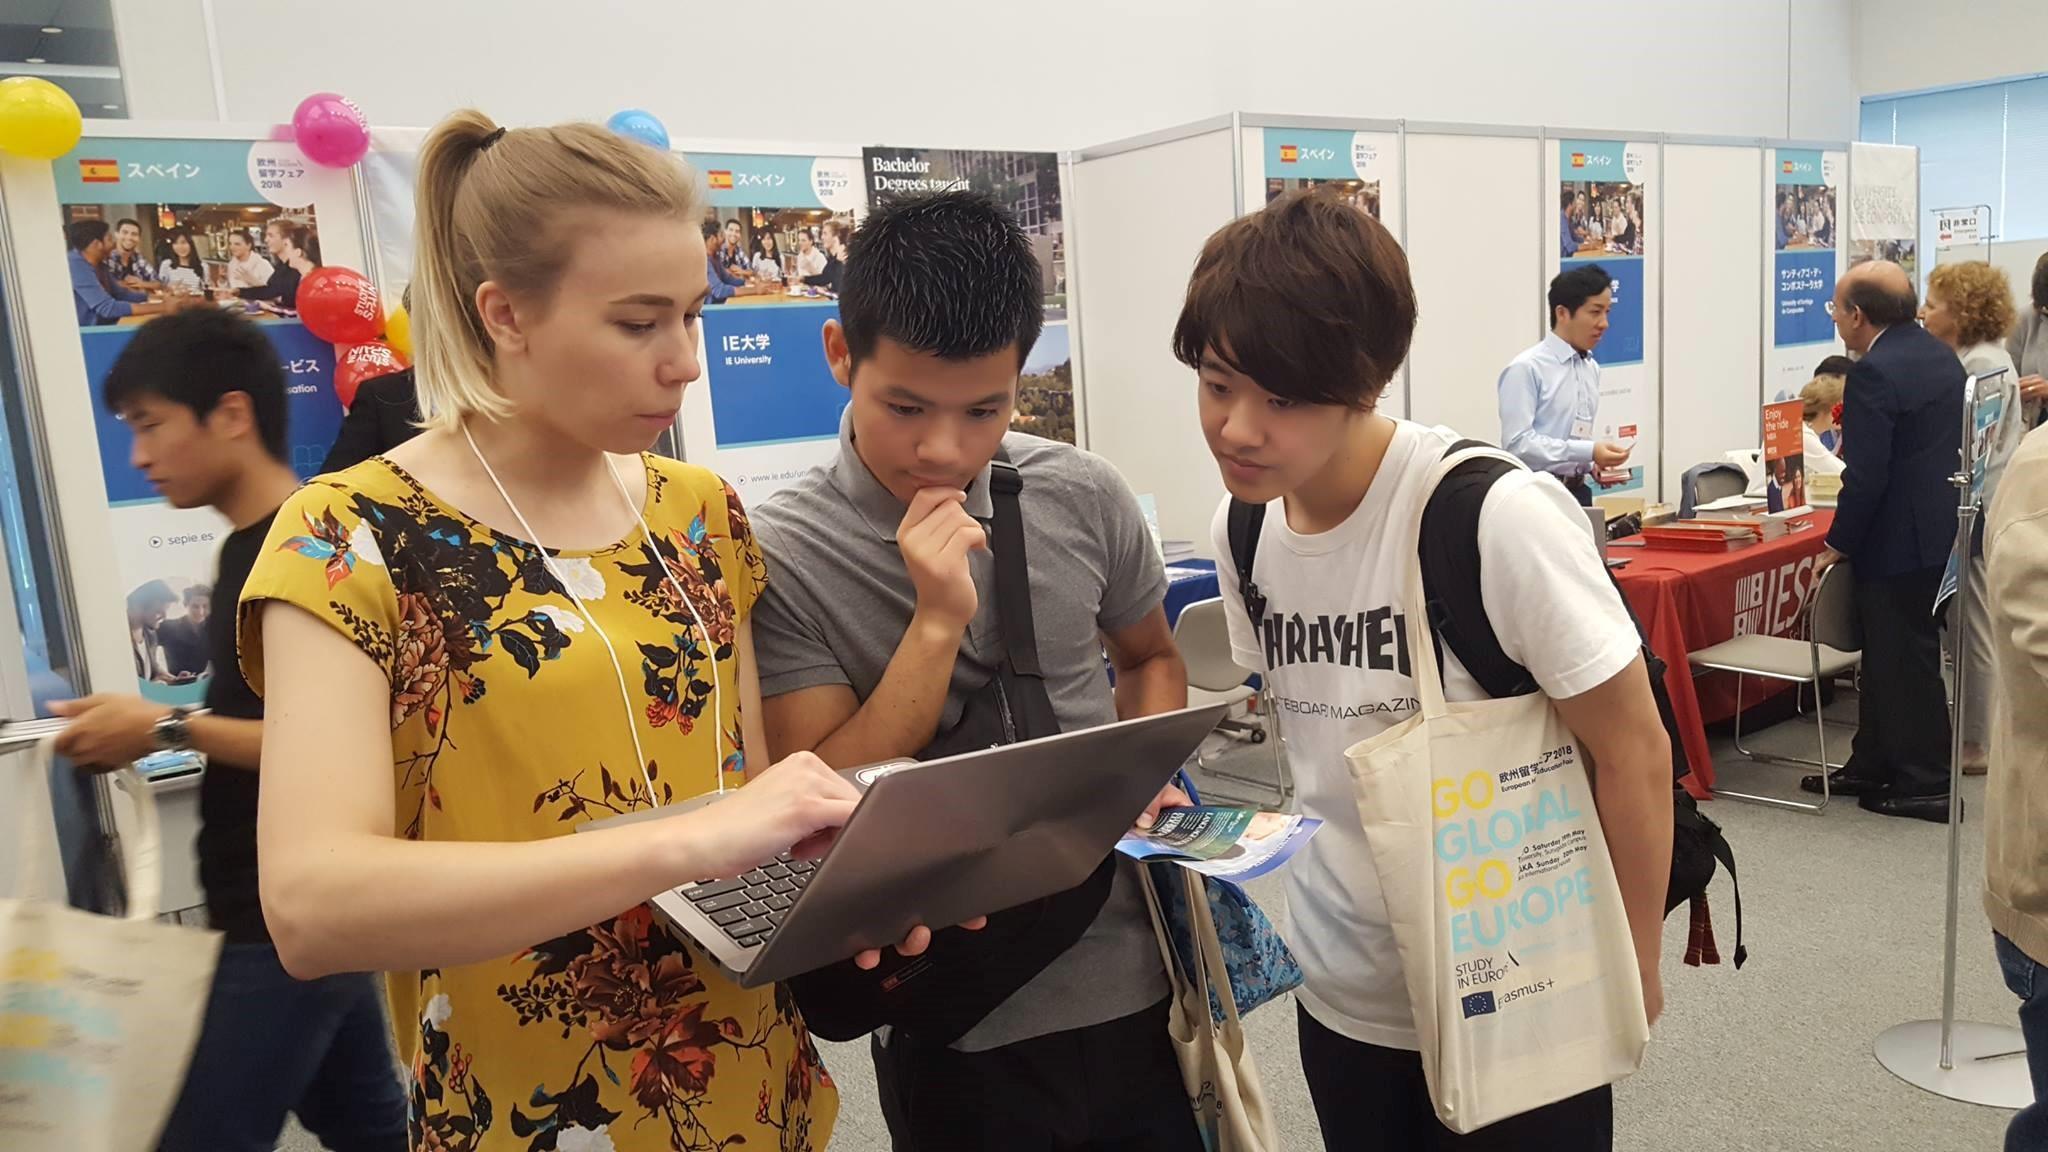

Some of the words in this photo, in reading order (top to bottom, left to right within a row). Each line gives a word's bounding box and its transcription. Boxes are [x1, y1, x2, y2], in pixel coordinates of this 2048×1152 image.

[127, 162, 201, 179] スペイン
[256, 158, 277, 168] 欧州
[872, 157, 930, 173] Bachelor
[260, 180, 283, 189] 2018
[738, 173, 785, 187] スペイン
[874, 175, 928, 192] Degrees
[722, 333, 771, 351] IE大学
[348, 345, 392, 358] SPAIN
[282, 359, 320, 373] ービス
[725, 357, 733, 365] IE
[734, 354, 772, 366] University
[287, 383, 318, 394] sation
[1765, 408, 1782, 421] Enjoy
[1264, 605, 1412, 678] HRASHE
[1331, 697, 1421, 719] MAGAZIN
[1431, 769, 1495, 819] GO
[1501, 780, 1531, 793] European
[1533, 839, 1561, 852] Saturday
[1572, 829, 1585, 837] May
[1536, 856, 1560, 868] Sunday
[1575, 845, 1588, 853] May
[1445, 859, 1513, 910] GO
[1451, 866, 1597, 953] EUROPE
[1455, 957, 1494, 977] STUDY
[1458, 976, 1470, 990] IN
